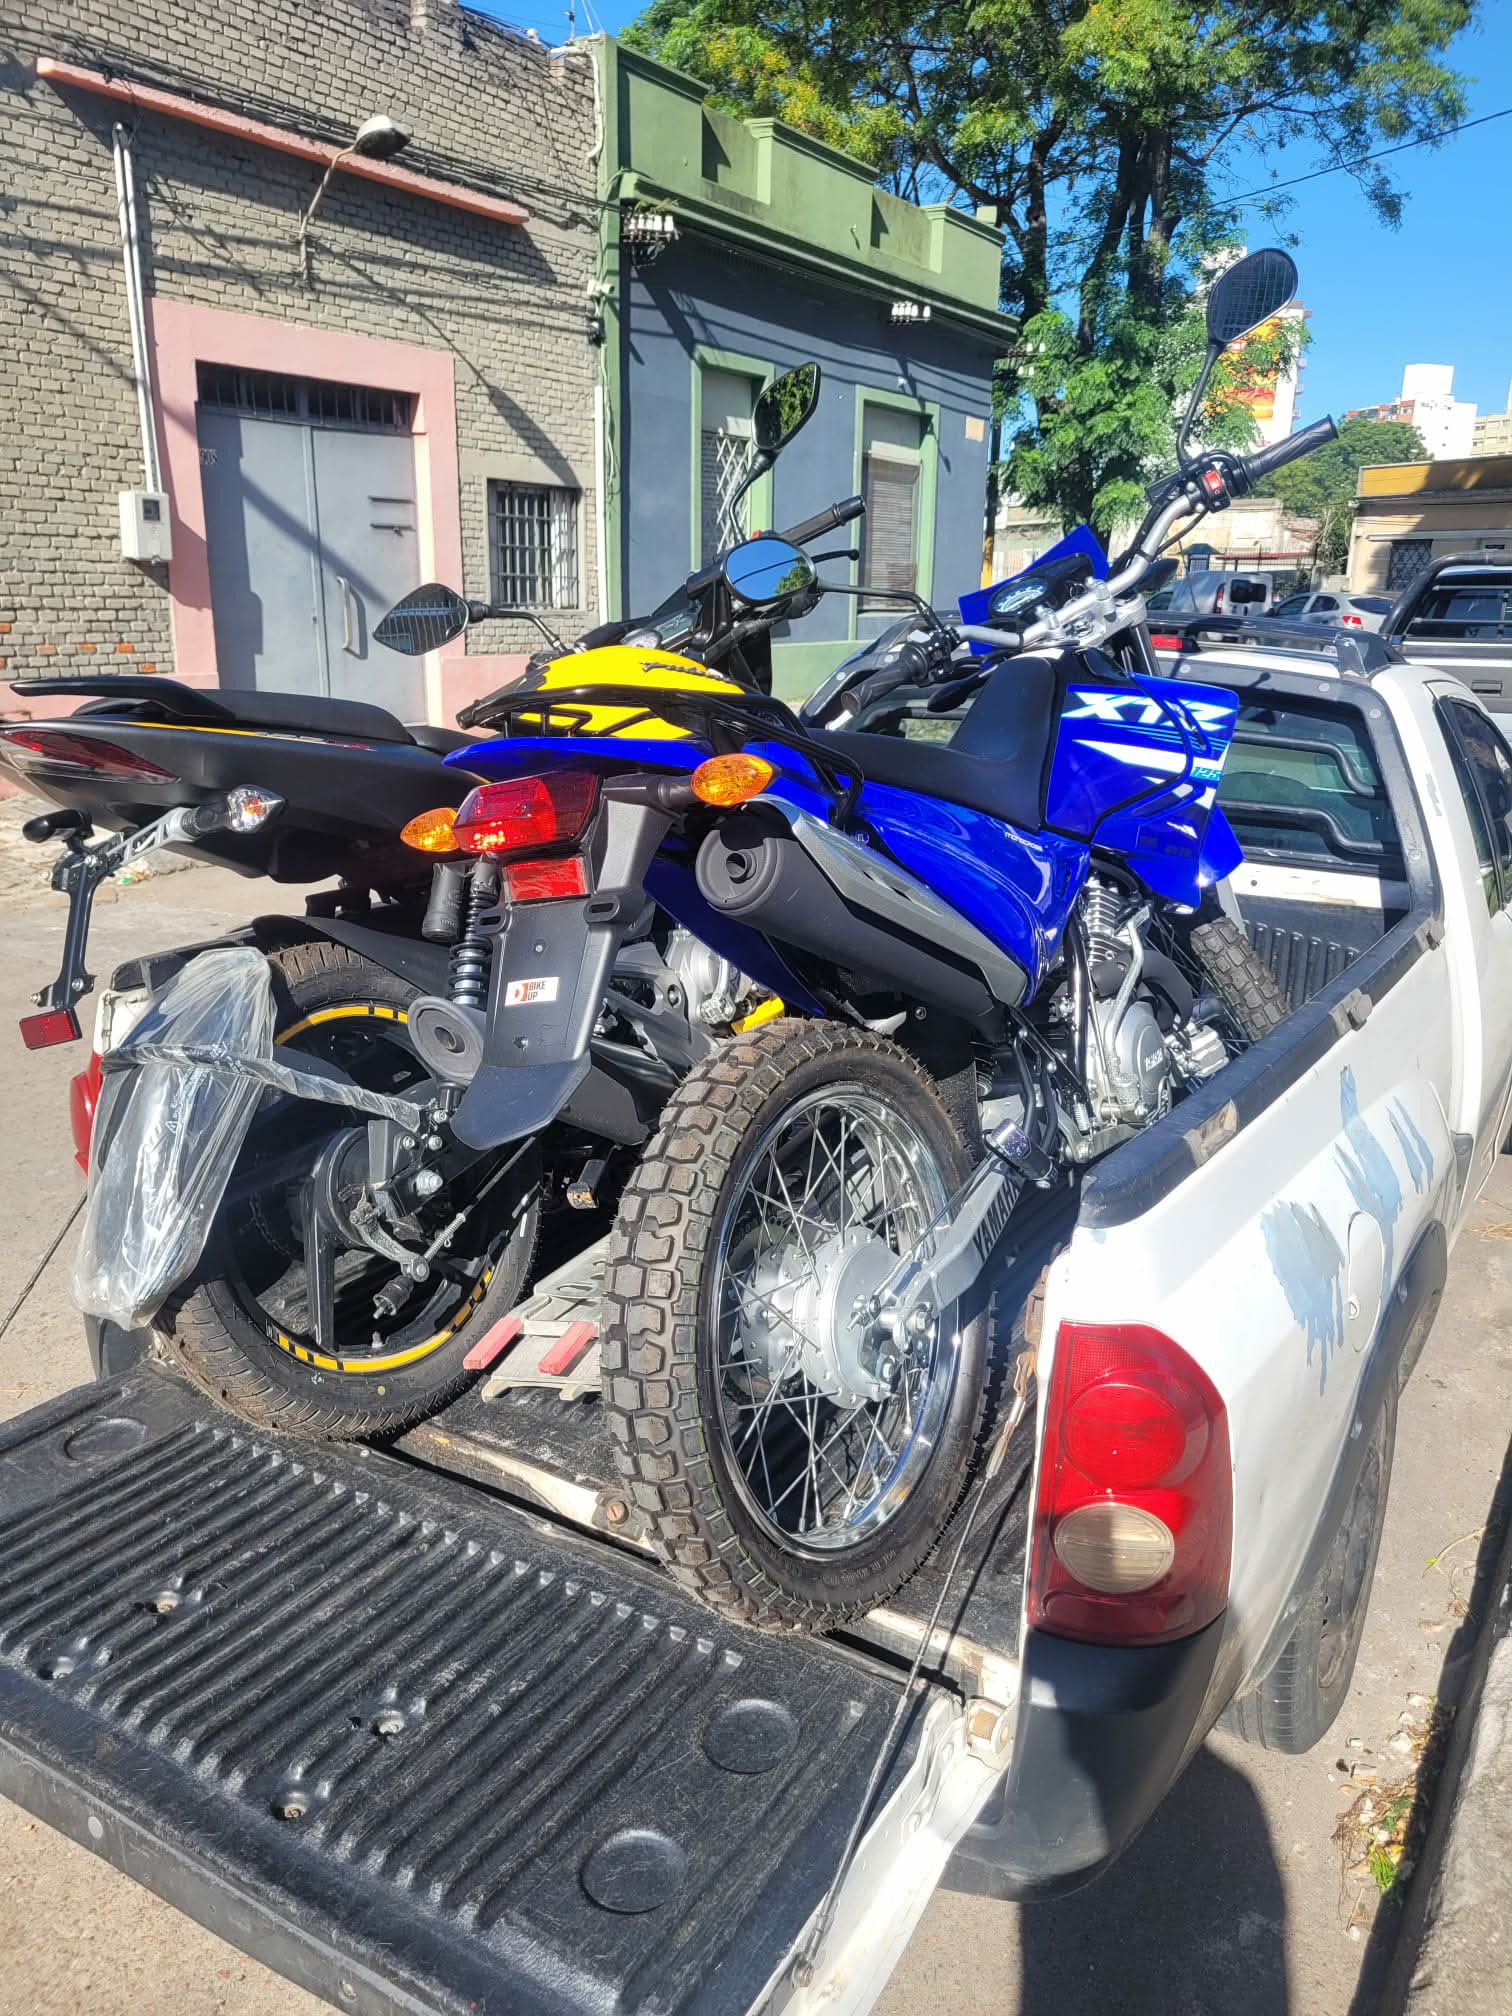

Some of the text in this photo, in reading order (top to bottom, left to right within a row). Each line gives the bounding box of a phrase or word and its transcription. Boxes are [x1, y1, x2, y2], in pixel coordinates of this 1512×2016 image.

[1061, 691, 1236, 732] XTZ
[1190, 766, 1221, 782] 125
[528, 980, 546, 991] BIKE
[527, 991, 538, 1001] UP
[973, 1178, 1021, 1264] YAMAHA
